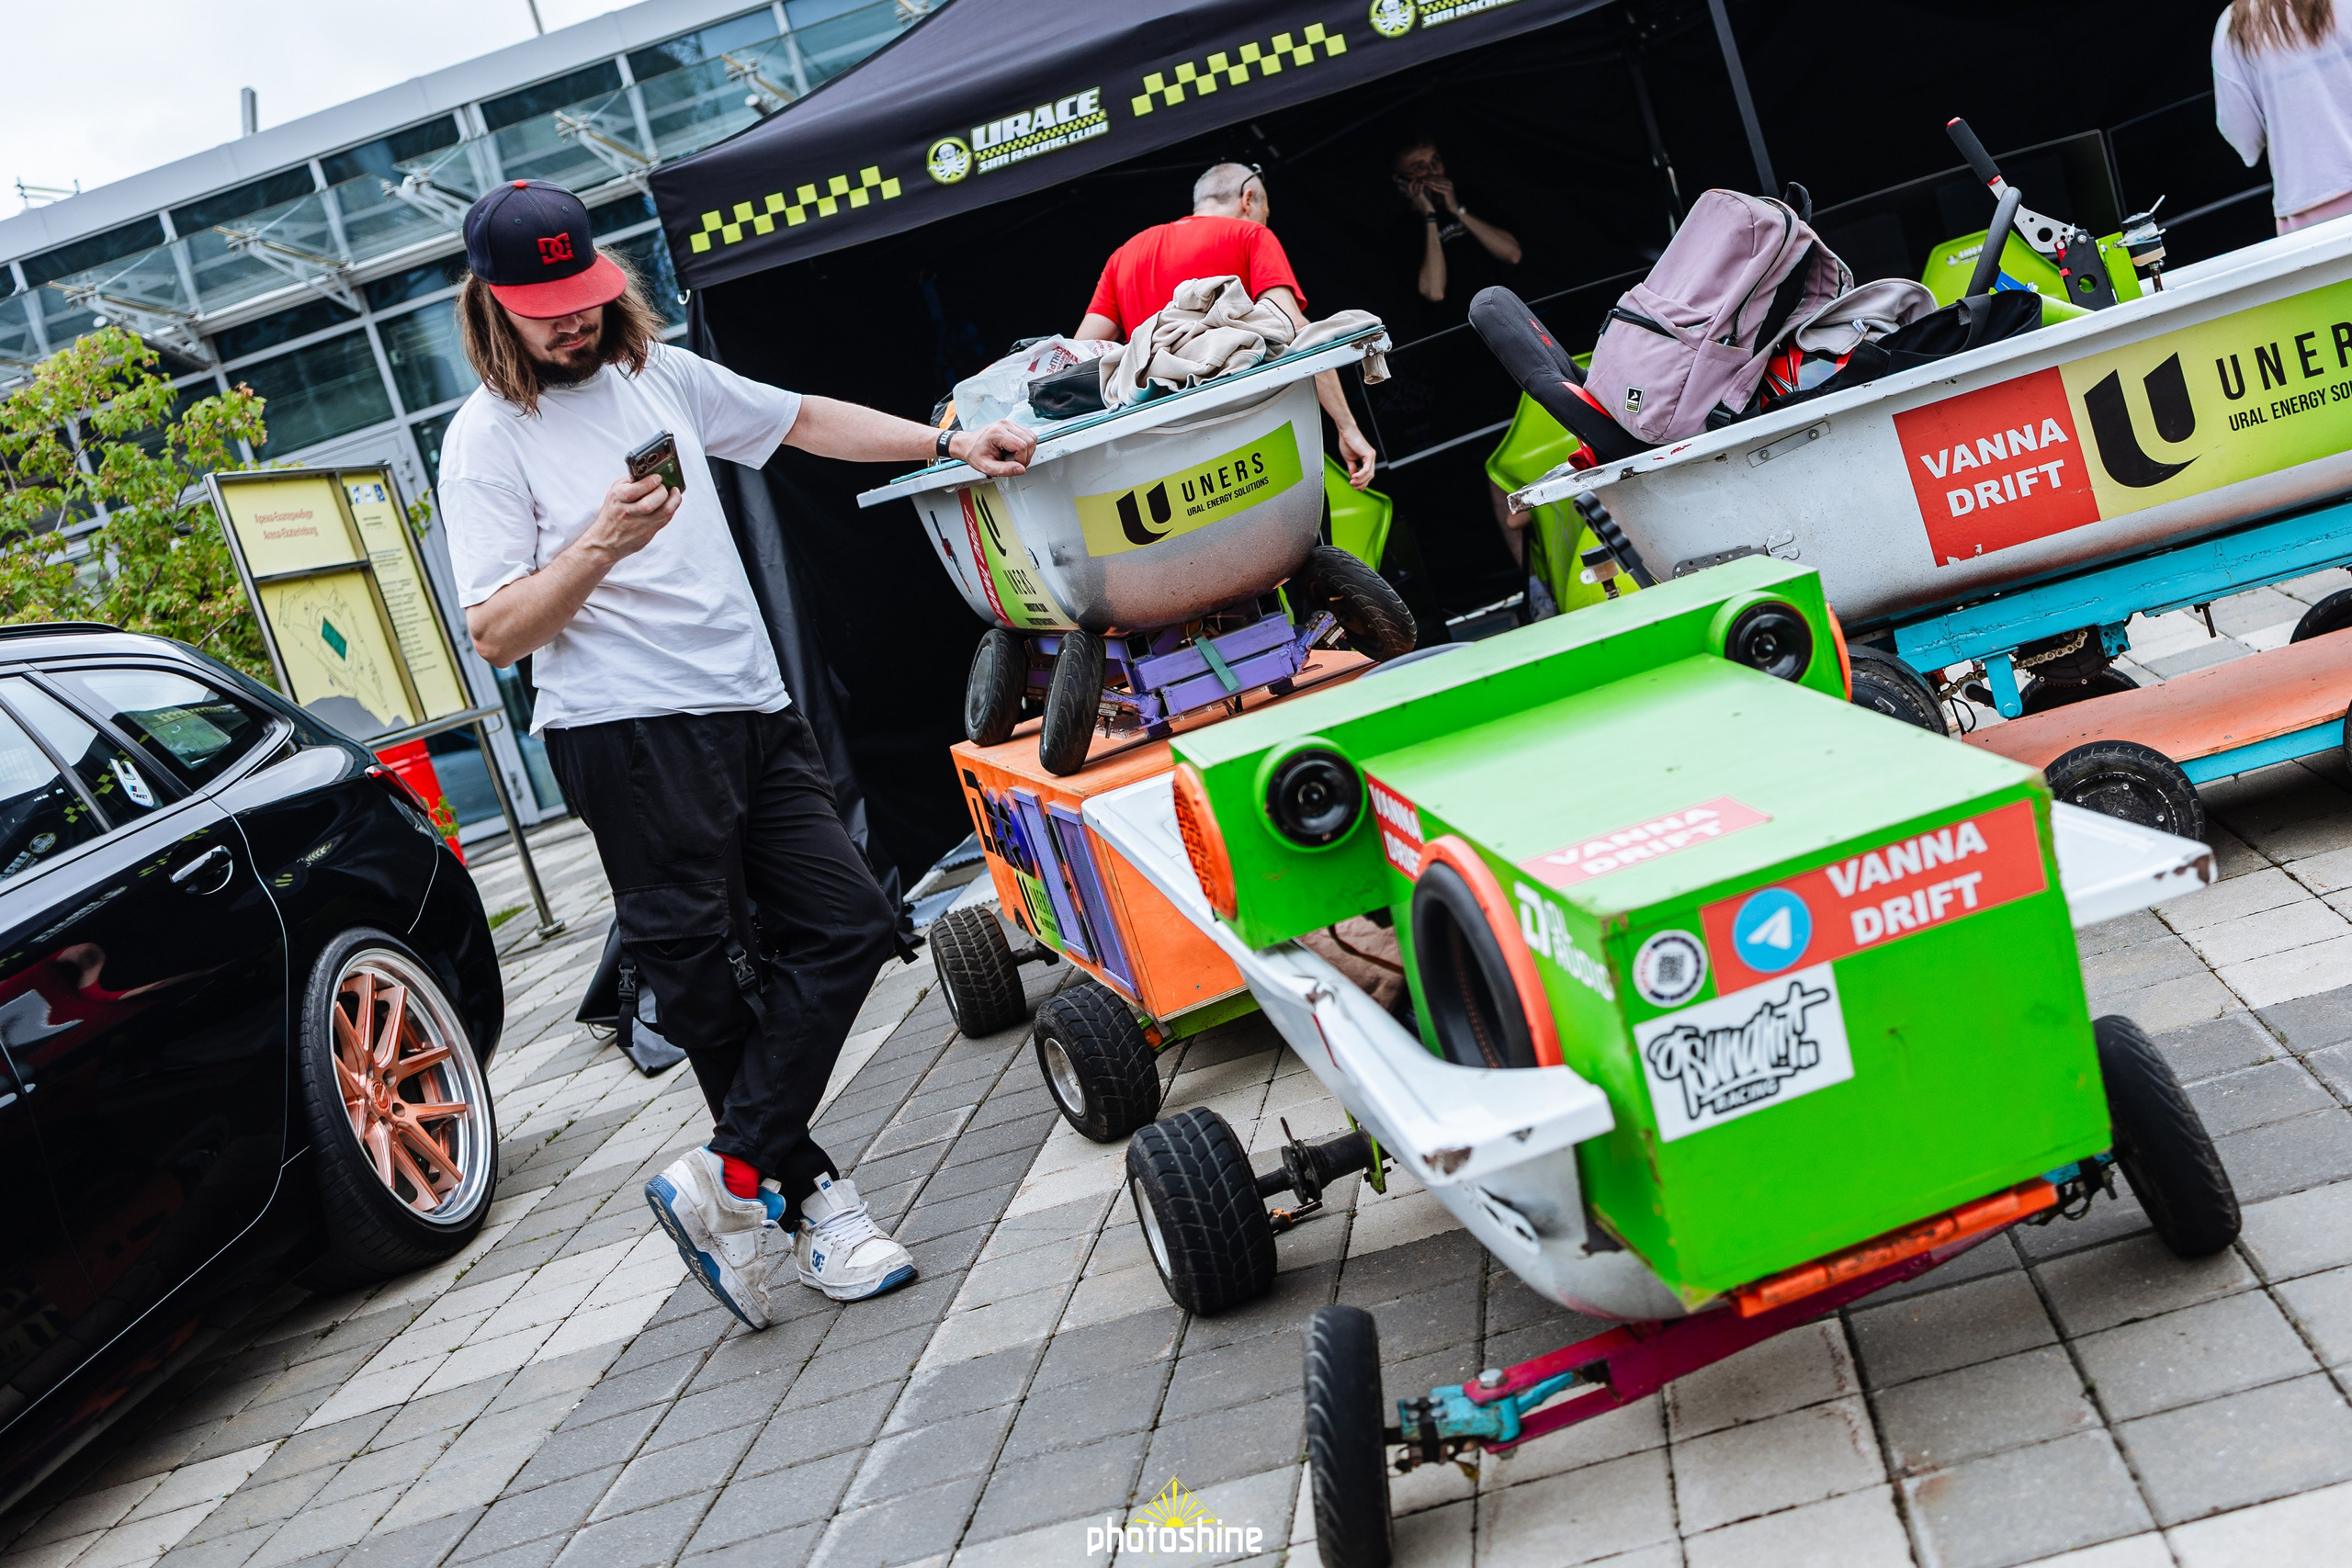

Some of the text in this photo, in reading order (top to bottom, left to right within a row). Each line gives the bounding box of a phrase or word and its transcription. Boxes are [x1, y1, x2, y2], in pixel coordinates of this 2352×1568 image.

[972, 88, 1100, 151] URACE
[978, 122, 1107, 172] SIM RACING CLUB
[2229, 380, 2352, 431] URAL ENERGY SO
[1920, 417, 2068, 479] VANNA
[1182, 452, 1264, 502] UNERS
[1187, 476, 1269, 516] URAL ENERGY SOLUTIONS
[1946, 459, 2064, 517] DRIFT
[1368, 783, 1425, 844] VANNA
[1544, 808, 1720, 865] VANNA
[1384, 830, 1422, 877] DRIF
[1580, 819, 1722, 875] DRIFT
[1825, 821, 1988, 898] VANNA
[1850, 871, 1983, 945] DRIFT
[1715, 1079, 1778, 1112] RACING
